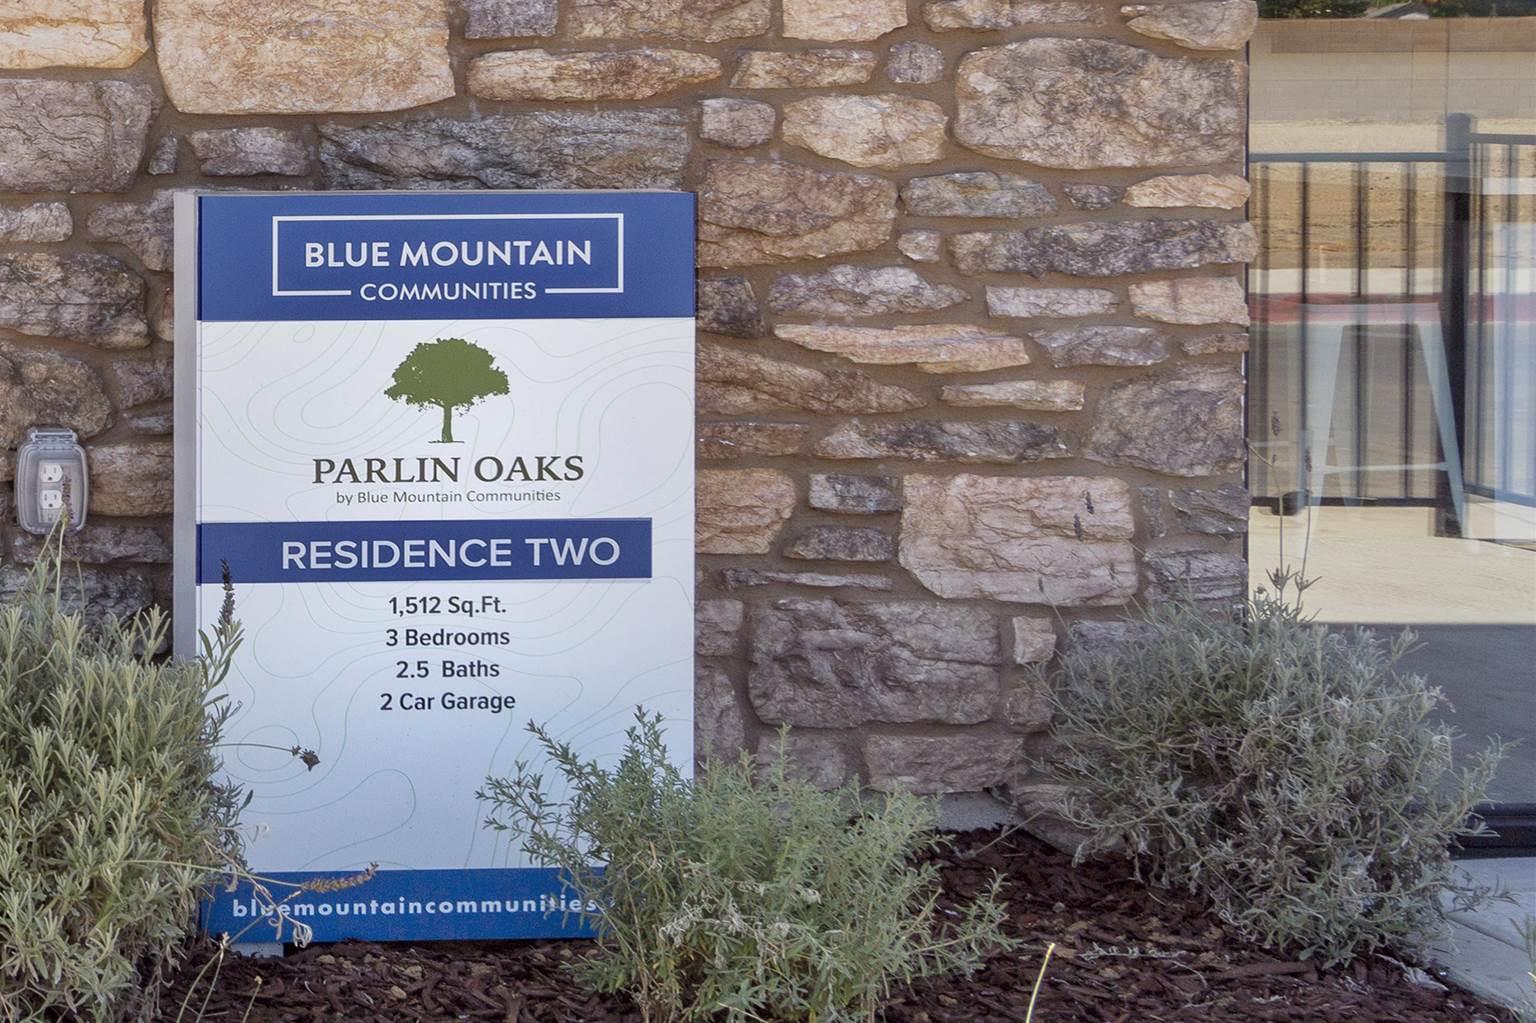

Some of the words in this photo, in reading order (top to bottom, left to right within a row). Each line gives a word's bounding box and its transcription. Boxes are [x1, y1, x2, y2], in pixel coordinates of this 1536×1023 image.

[304, 241, 389, 267] BLUE
[400, 240, 592, 267] MOUNTAIN
[360, 281, 537, 301] COMMUNITIES
[312, 456, 462, 484] PARLIN
[474, 454, 585, 482] OAKS
[336, 489, 354, 505] by
[357, 488, 390, 504] Blue
[393, 488, 462, 504] Mountain
[466, 488, 561, 503] Communities
[281, 538, 512, 569] RESIDENCE
[525, 536, 621, 567] TWO
[388, 596, 442, 617] 1,512
[448, 595, 507, 618] Sq.Ft.
[385, 628, 400, 647] 3
[405, 627, 511, 647] Bedrooms
[396, 661, 430, 679] 2.5
[442, 660, 500, 678] Baths
[379, 693, 393, 711] 2
[399, 692, 435, 711] Car
[441, 692, 516, 714] Garage
